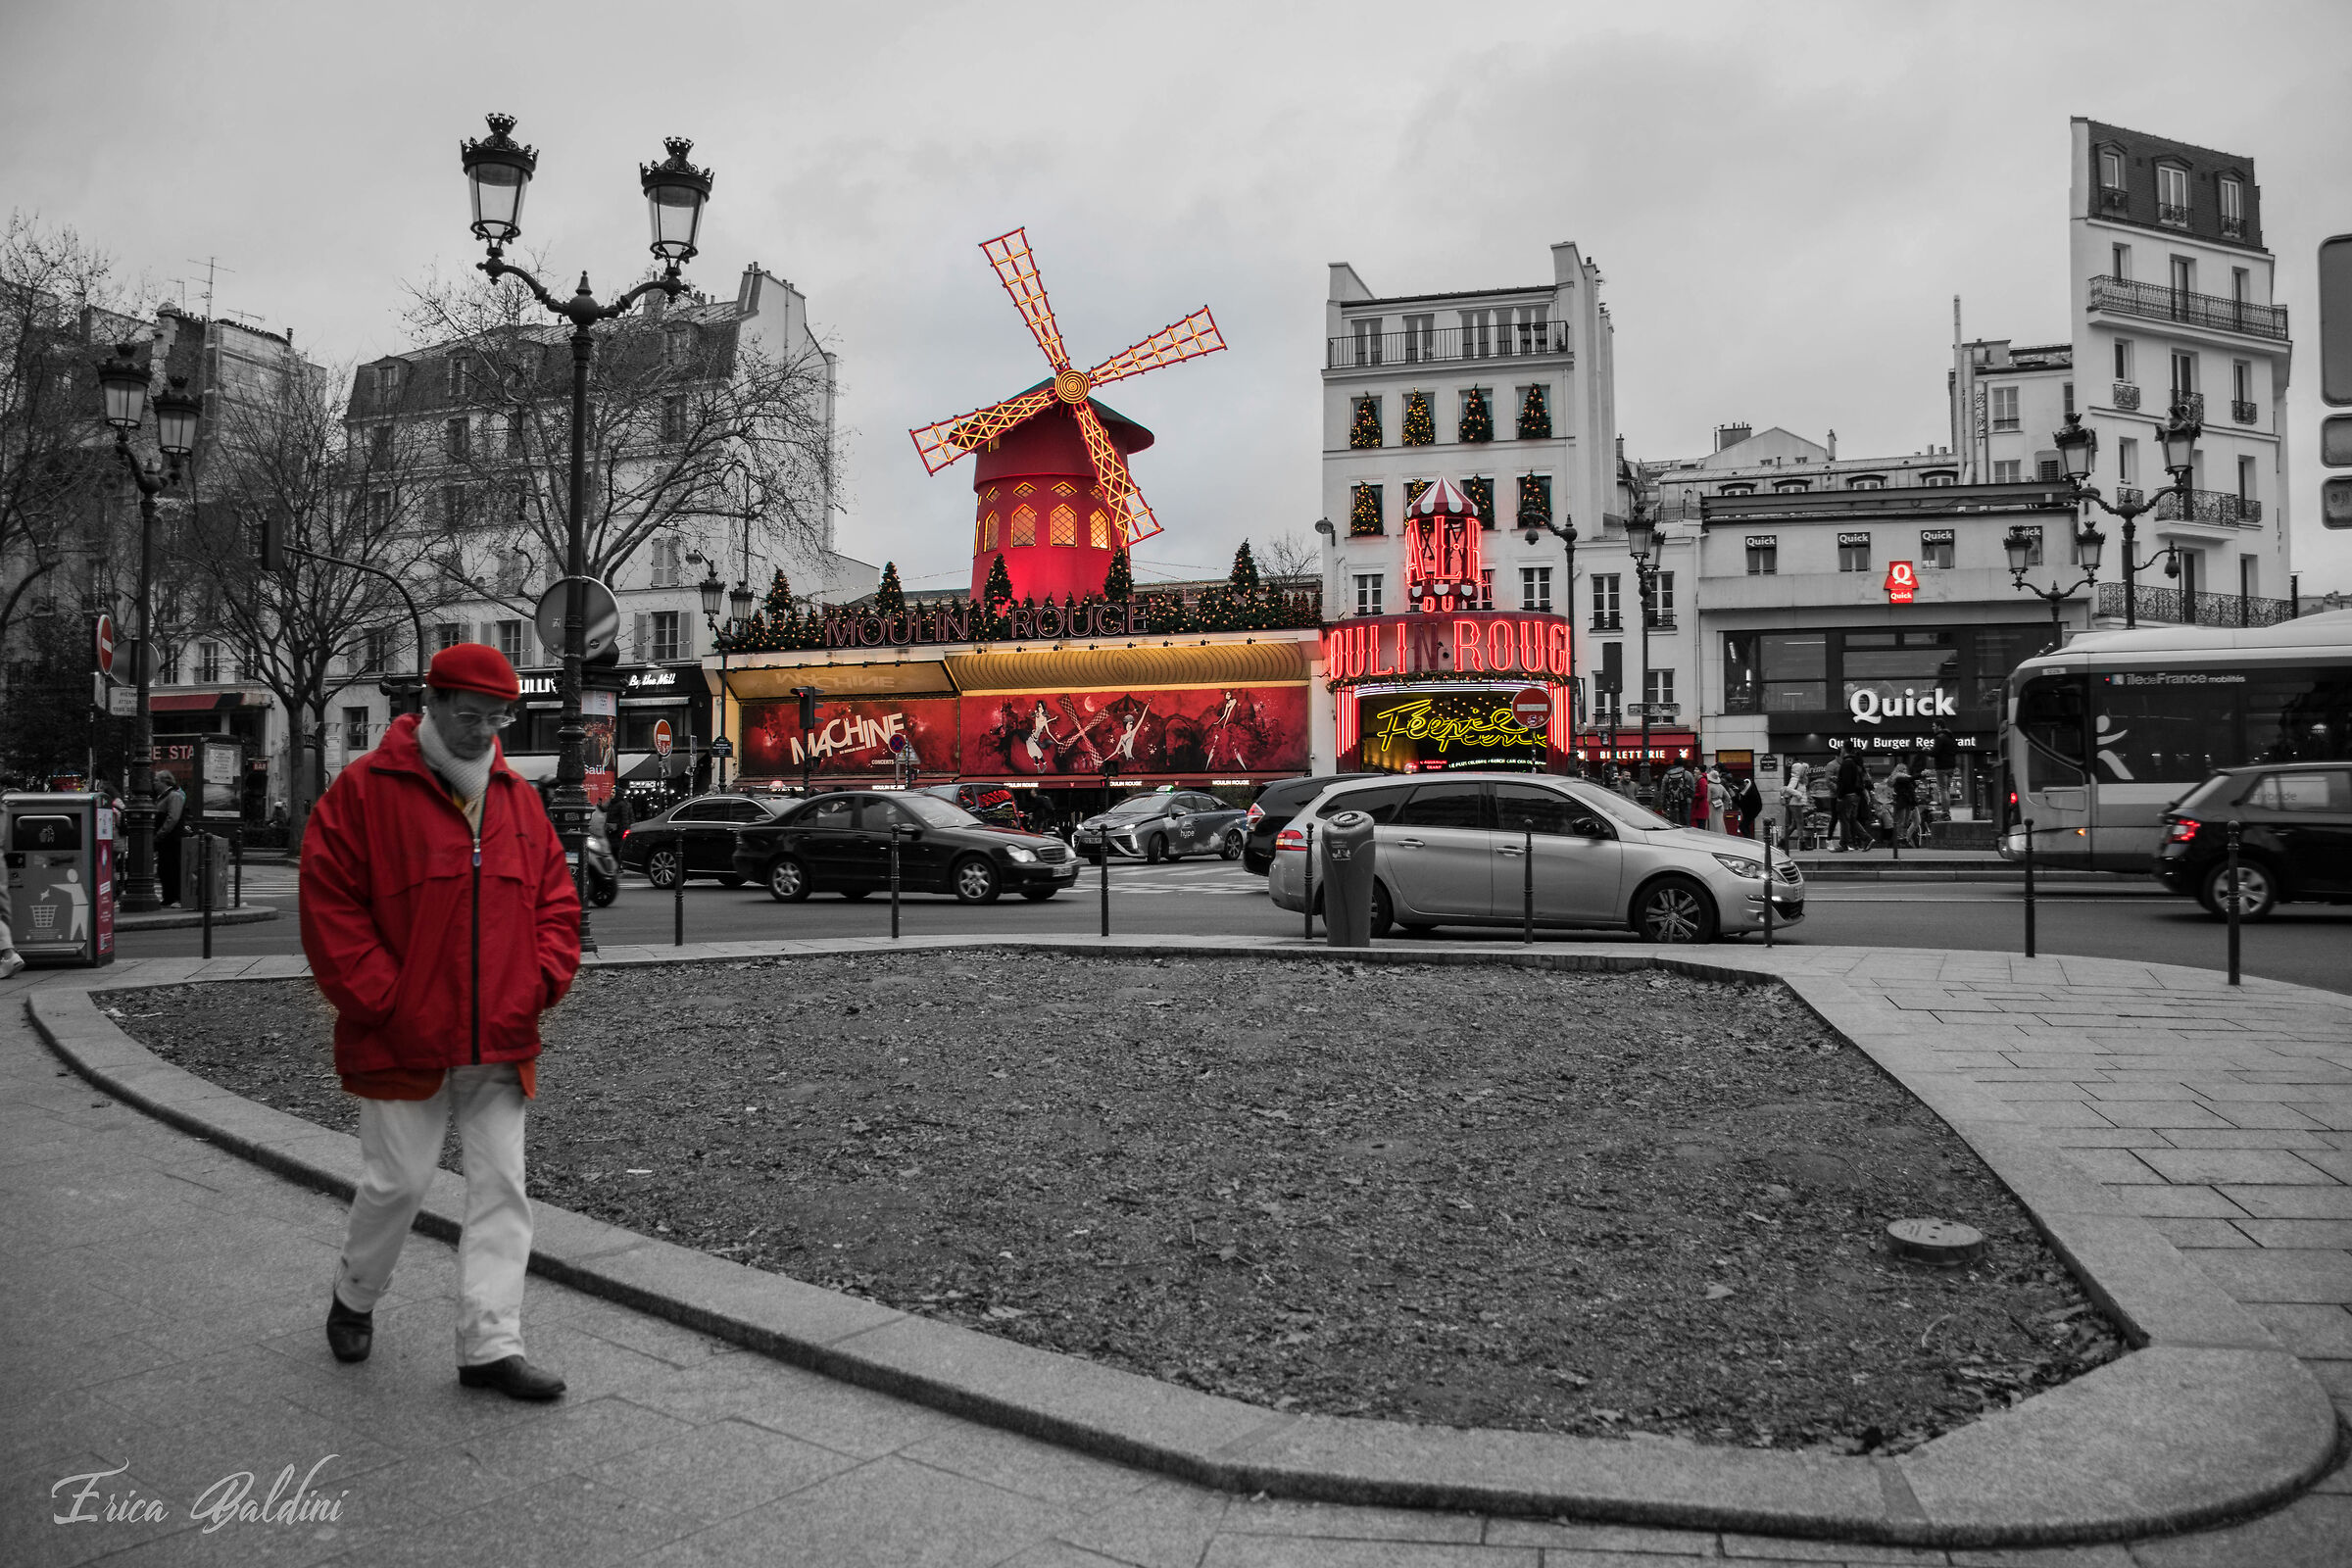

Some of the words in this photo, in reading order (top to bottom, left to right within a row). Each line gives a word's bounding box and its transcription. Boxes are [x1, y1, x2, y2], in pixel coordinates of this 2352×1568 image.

[1745, 535, 1776, 547] Quick
[1838, 533, 1870, 544] Quick
[1922, 530, 1953, 542] Quick
[1891, 564, 1913, 586] Q
[1423, 595, 1454, 612] DU
[1890, 592, 1912, 601] Quick
[826, 611, 969, 647] MOULIN
[1011, 603, 1150, 638] ROUGE
[1330, 621, 1440, 680] OULIN
[1453, 619, 1570, 677] ROUG
[642, 673, 657, 686] the
[657, 672, 676, 685] Mill
[2208, 674, 2246, 683] mobilités
[1848, 687, 1957, 724] Quick
[790, 713, 906, 765] MACHINE
[1828, 737, 1869, 750] Quity
[1873, 737, 1911, 750] Burger
[1915, 736, 1977, 748] Resant
[1599, 750, 1666, 760] BILETTRIE
[584, 764, 606, 775] Saül
